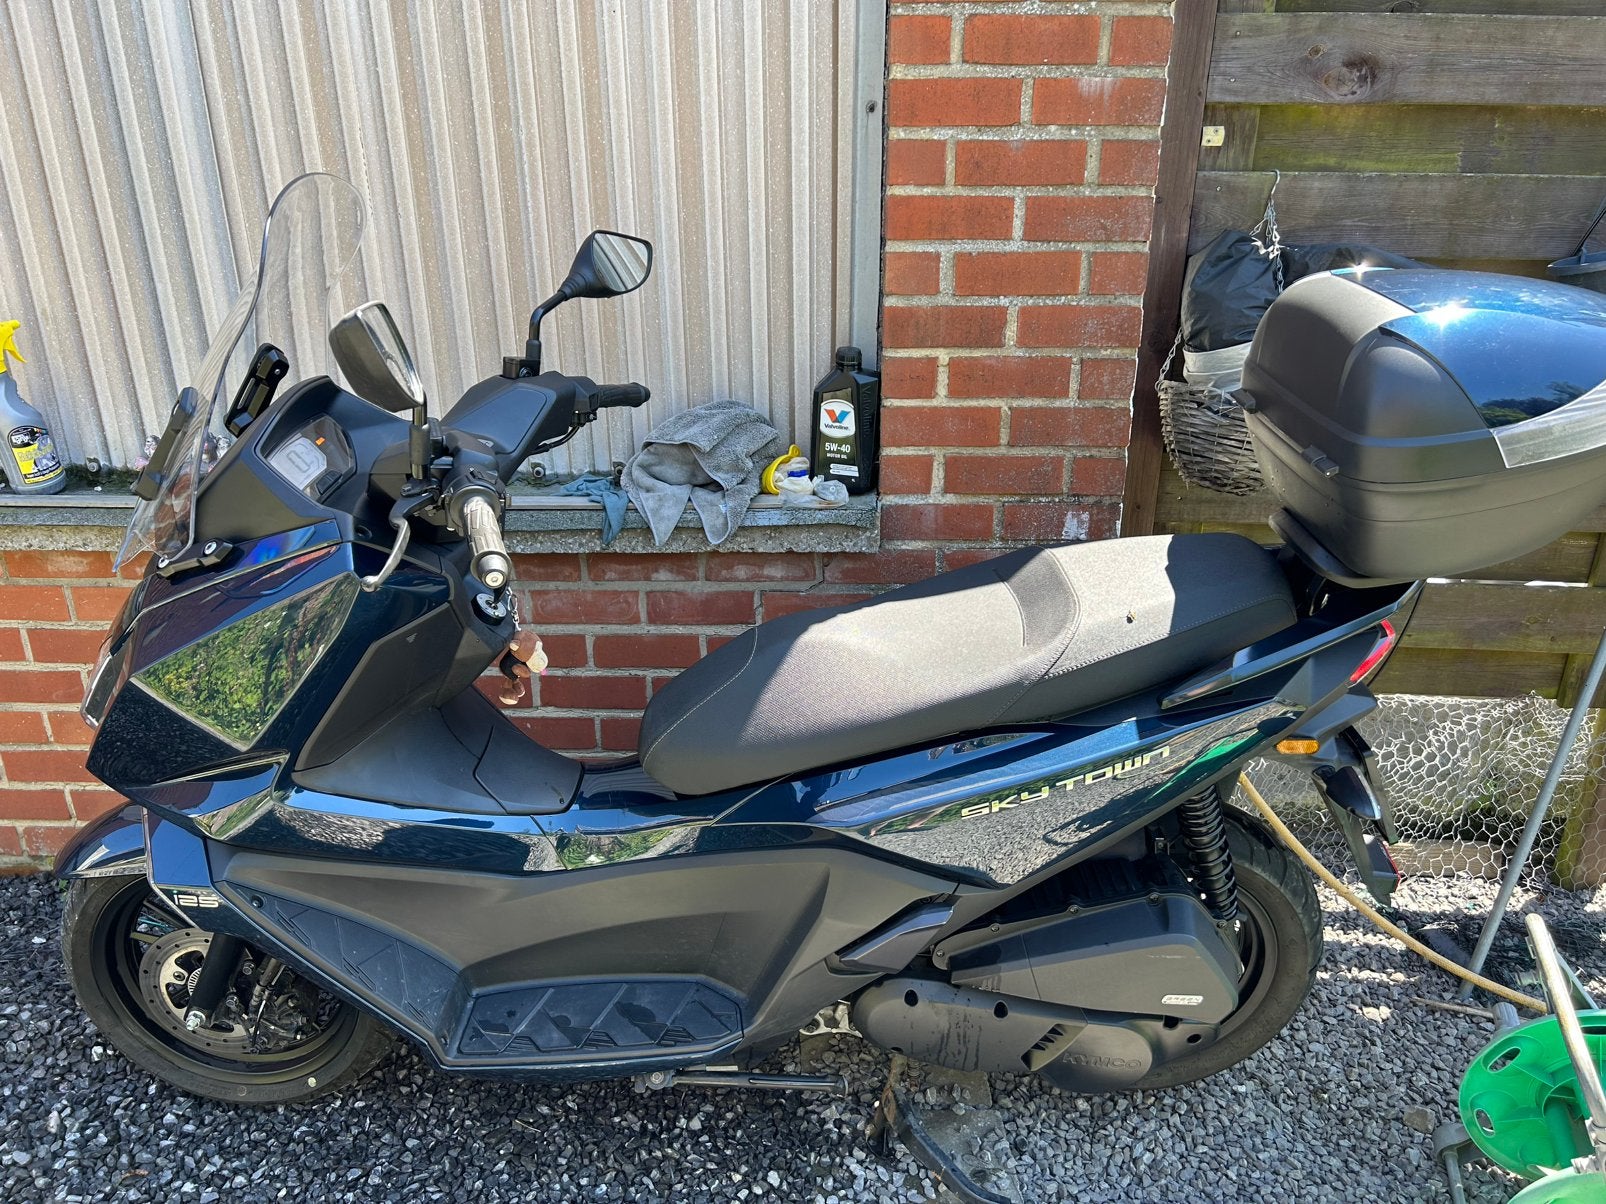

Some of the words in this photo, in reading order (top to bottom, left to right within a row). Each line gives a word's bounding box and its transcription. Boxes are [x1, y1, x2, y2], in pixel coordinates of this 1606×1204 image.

[824, 423, 850, 431] Valvoline
[825, 442, 851, 453] 5W-40
[960, 786, 1049, 820] SKY
[1056, 745, 1170, 791] TOWN
[173, 894, 219, 908] 125
[1062, 1052, 1142, 1069] KYMCO
